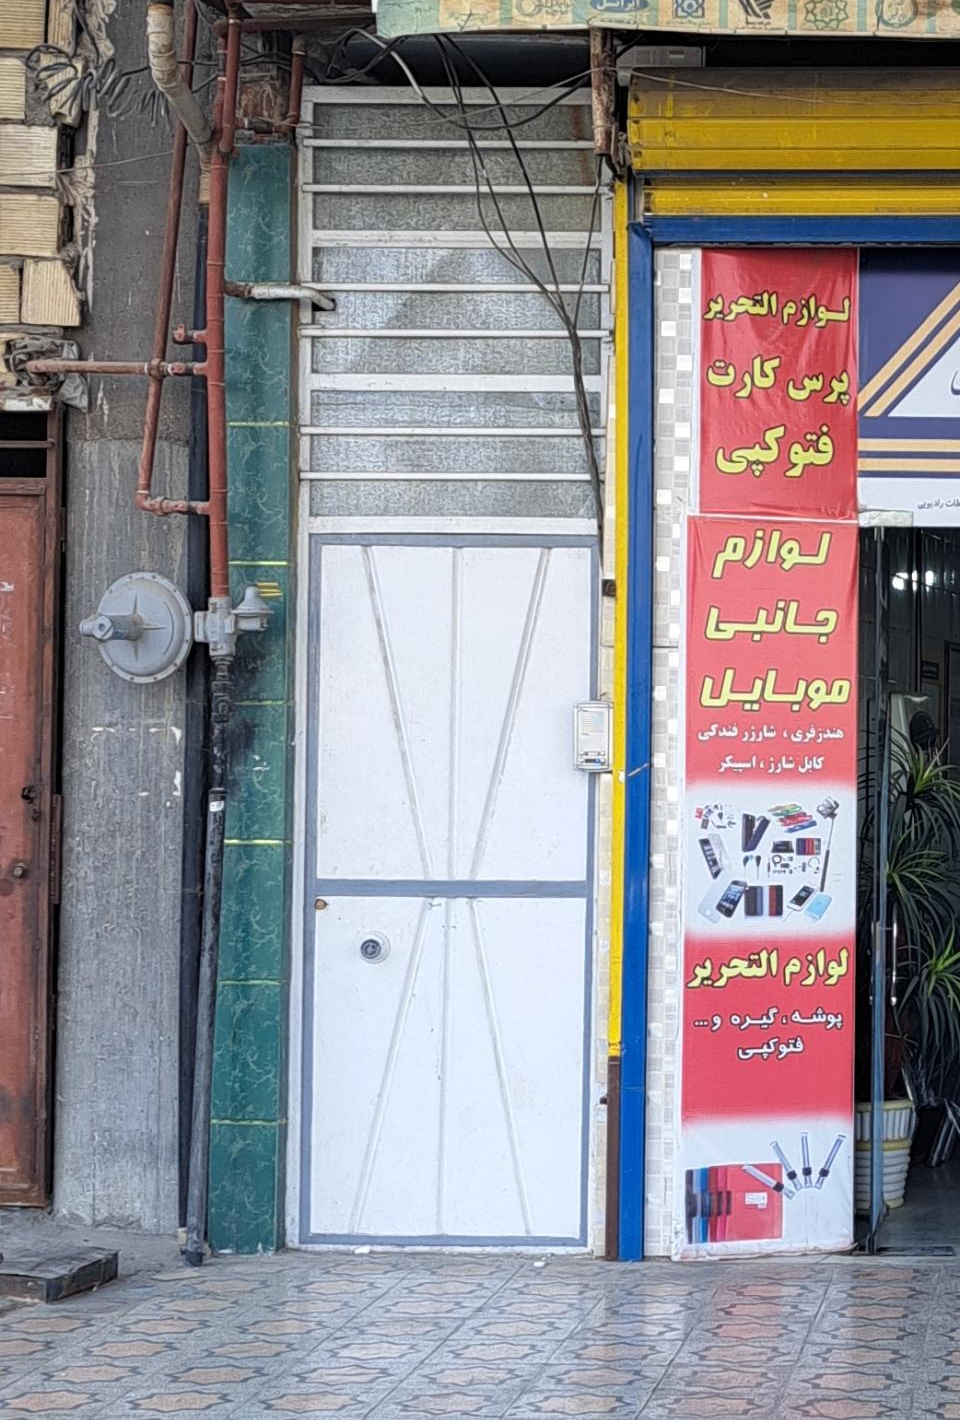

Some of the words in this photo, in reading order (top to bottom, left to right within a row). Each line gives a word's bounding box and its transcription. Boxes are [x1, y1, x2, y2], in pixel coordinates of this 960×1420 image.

[704, 290, 778, 321] التحریر
[781, 293, 850, 328] لوازم
[707, 355, 781, 398] کارت
[787, 371, 851, 405] پرس
[712, 528, 832, 579] لوازم
[705, 600, 838, 643] جانبی
[700, 667, 852, 712] موبایل
[698, 724, 738, 740] فندکی
[791, 725, 843, 743] هندزفری
[718, 755, 755, 772] اسپیکر
[768, 755, 794, 774] شارژ
[798, 756, 824, 773] کابل
[687, 946, 780, 988] التحریر
[783, 947, 850, 986] لوازم
[730, 1007, 778, 1029] گیره
[791, 1007, 843, 1029] پوشه
[737, 1036, 804, 1060] فتوکپی
